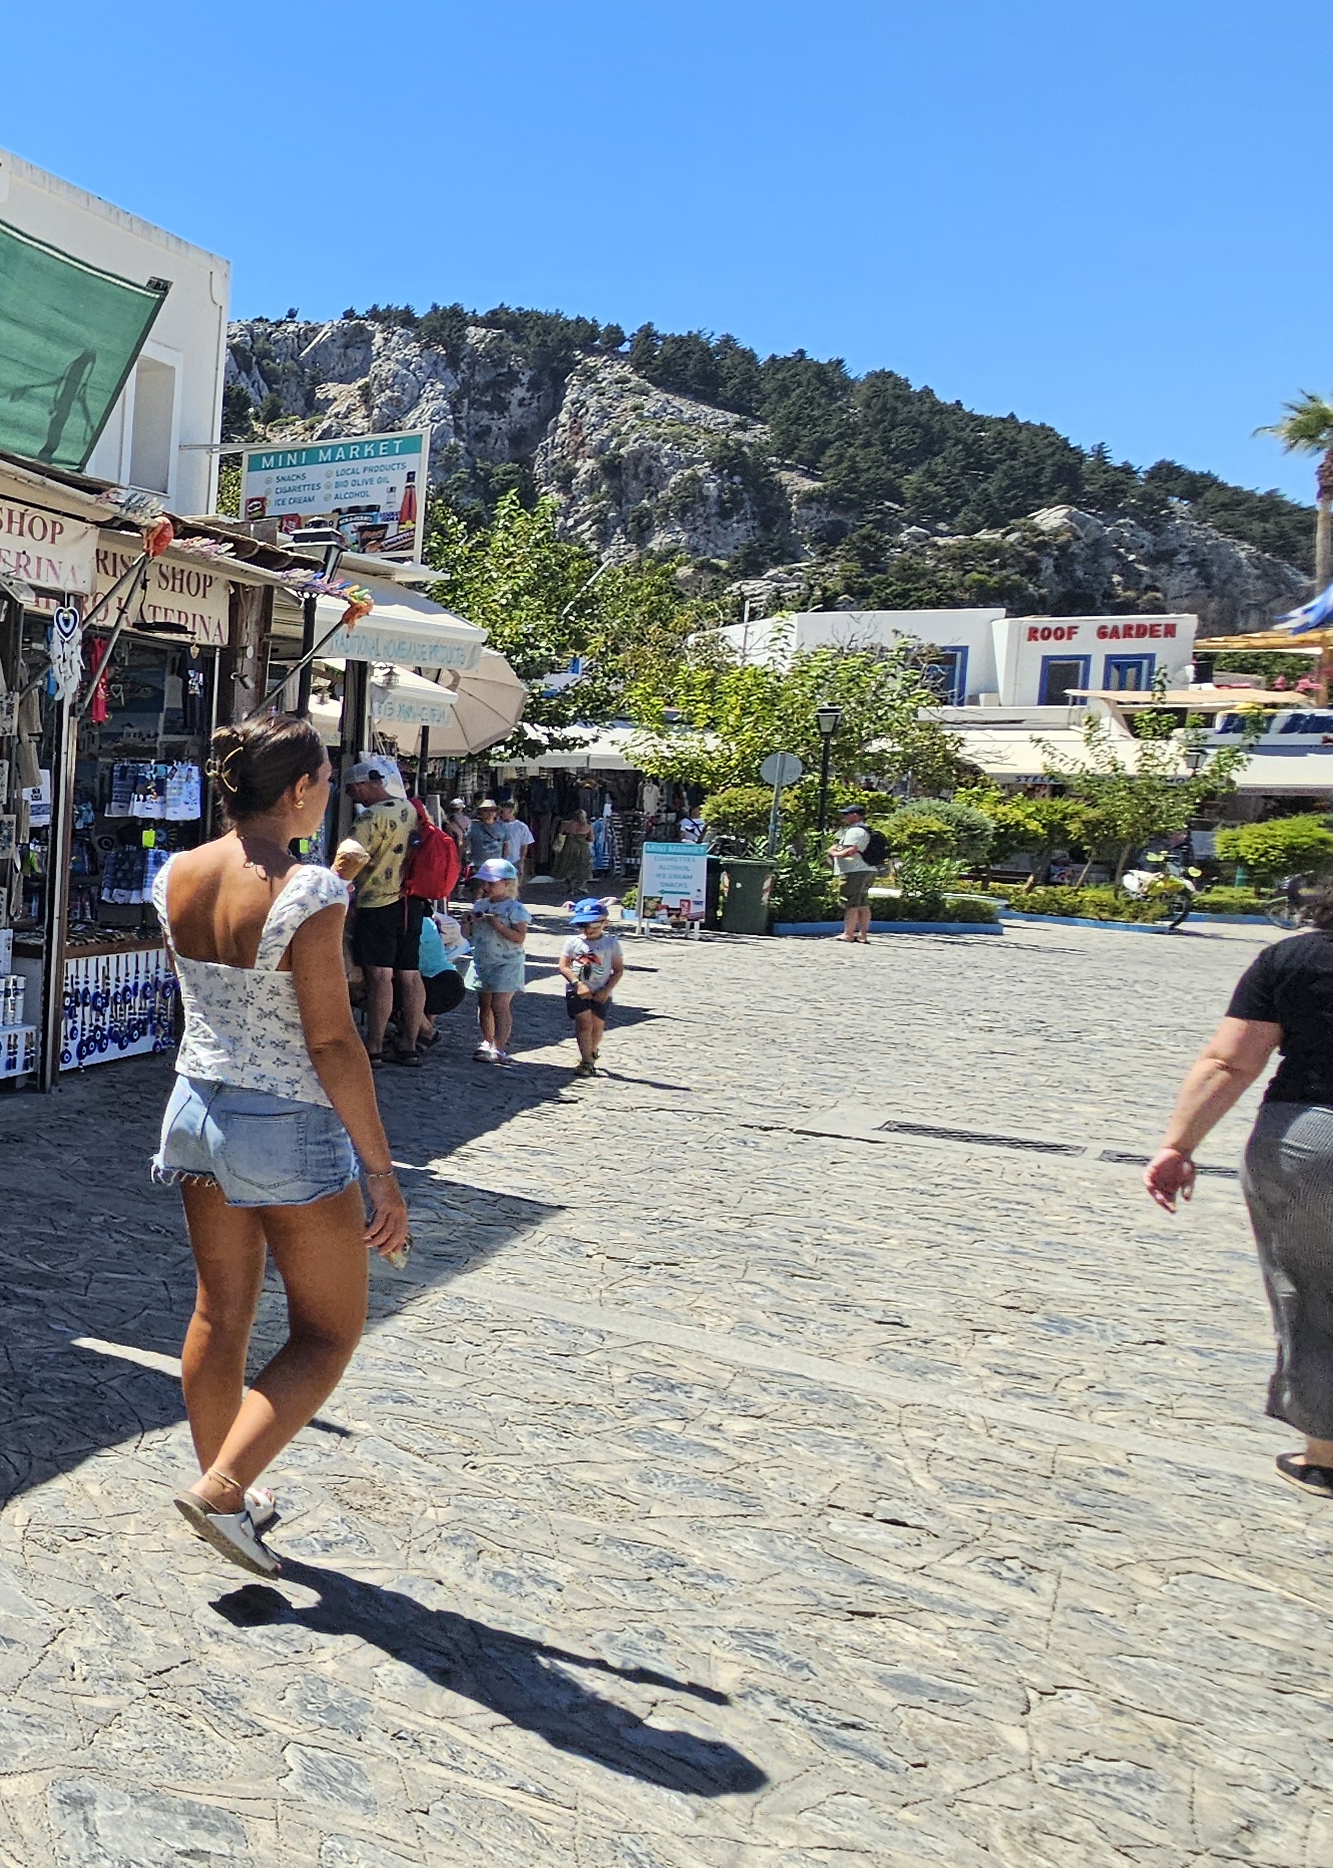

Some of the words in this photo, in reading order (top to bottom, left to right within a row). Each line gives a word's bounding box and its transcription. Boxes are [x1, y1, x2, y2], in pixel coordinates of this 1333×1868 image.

[261, 452, 307, 469] MINI
[318, 440, 403, 463] MARKET
[335, 467, 361, 478] LOCAL
[363, 462, 407, 474] PRODUCTS
[275, 473, 307, 483] SNACKS
[351, 477, 375, 488] OLIVE
[376, 476, 390, 485] OIL
[274, 483, 322, 495] CIGARETTES
[274, 498, 287, 507] ICE
[288, 495, 316, 505] CREAM
[334, 490, 371, 501] ALCOHOL
[157, 563, 214, 600] SHOP
[1026, 625, 1080, 642] ROOF
[1096, 623, 1178, 640] GARDEN
